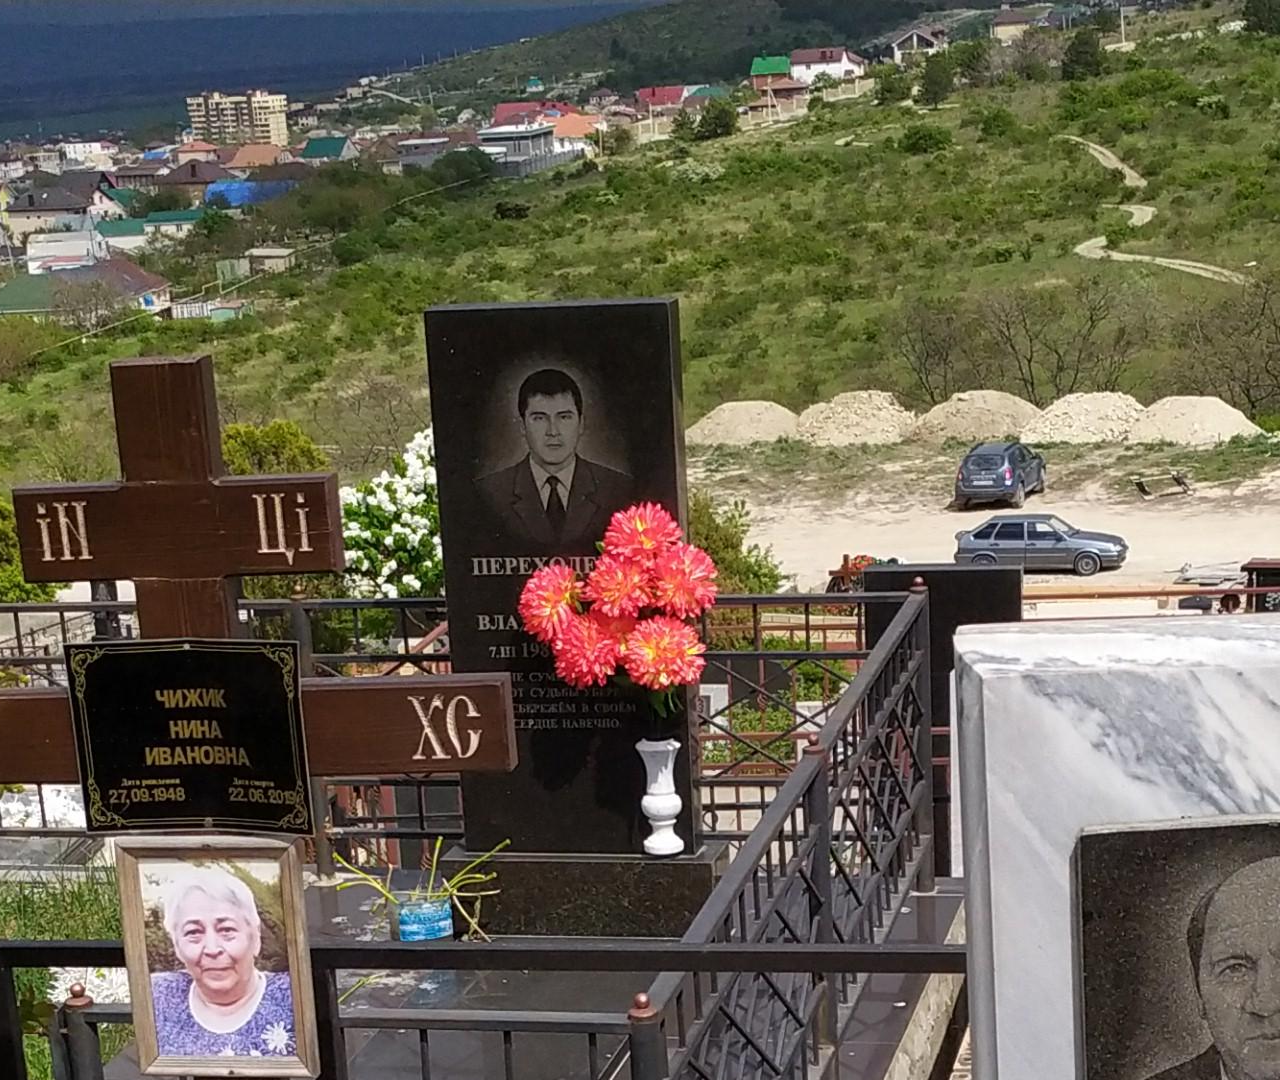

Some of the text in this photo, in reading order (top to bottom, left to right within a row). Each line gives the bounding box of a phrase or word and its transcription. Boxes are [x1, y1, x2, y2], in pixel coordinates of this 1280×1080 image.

[477, 614, 525, 632] ВЛА
[521, 642, 551, 659] 198
[155, 688, 227, 709] ЧИЖИК
[169, 719, 223, 739] НИНА
[144, 744, 252, 767] ИВАНОВНА
[108, 786, 186, 804] 27.09.1948
